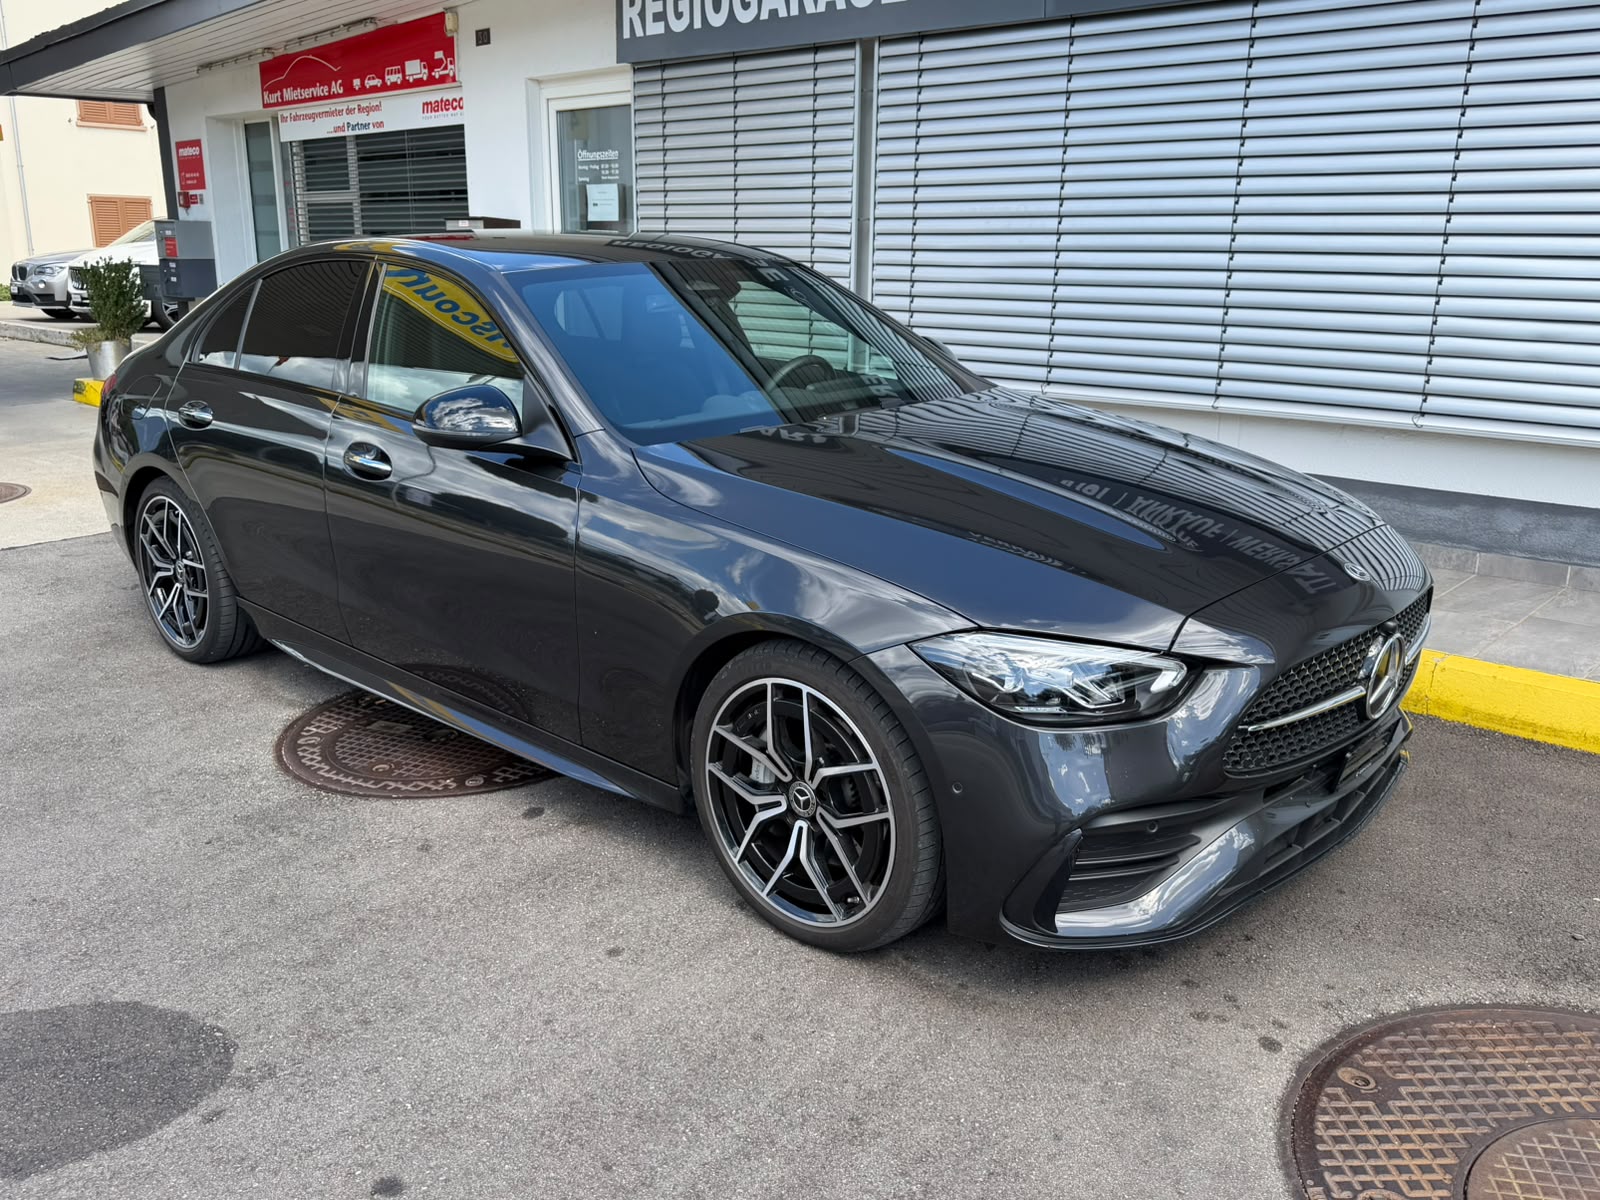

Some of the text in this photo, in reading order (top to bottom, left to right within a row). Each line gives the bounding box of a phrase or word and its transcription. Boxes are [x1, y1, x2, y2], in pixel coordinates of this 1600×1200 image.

[263, 80, 344, 104] Kurt Mietservice AG
[280, 101, 382, 123] Ihr Fahrzeugvermieter der Region!
[422, 97, 464, 114] mateco
[346, 121, 371, 132] Partner
[371, 120, 385, 129] von
[179, 146, 200, 157] mateco
[577, 149, 619, 161] Öffnungszeiten
